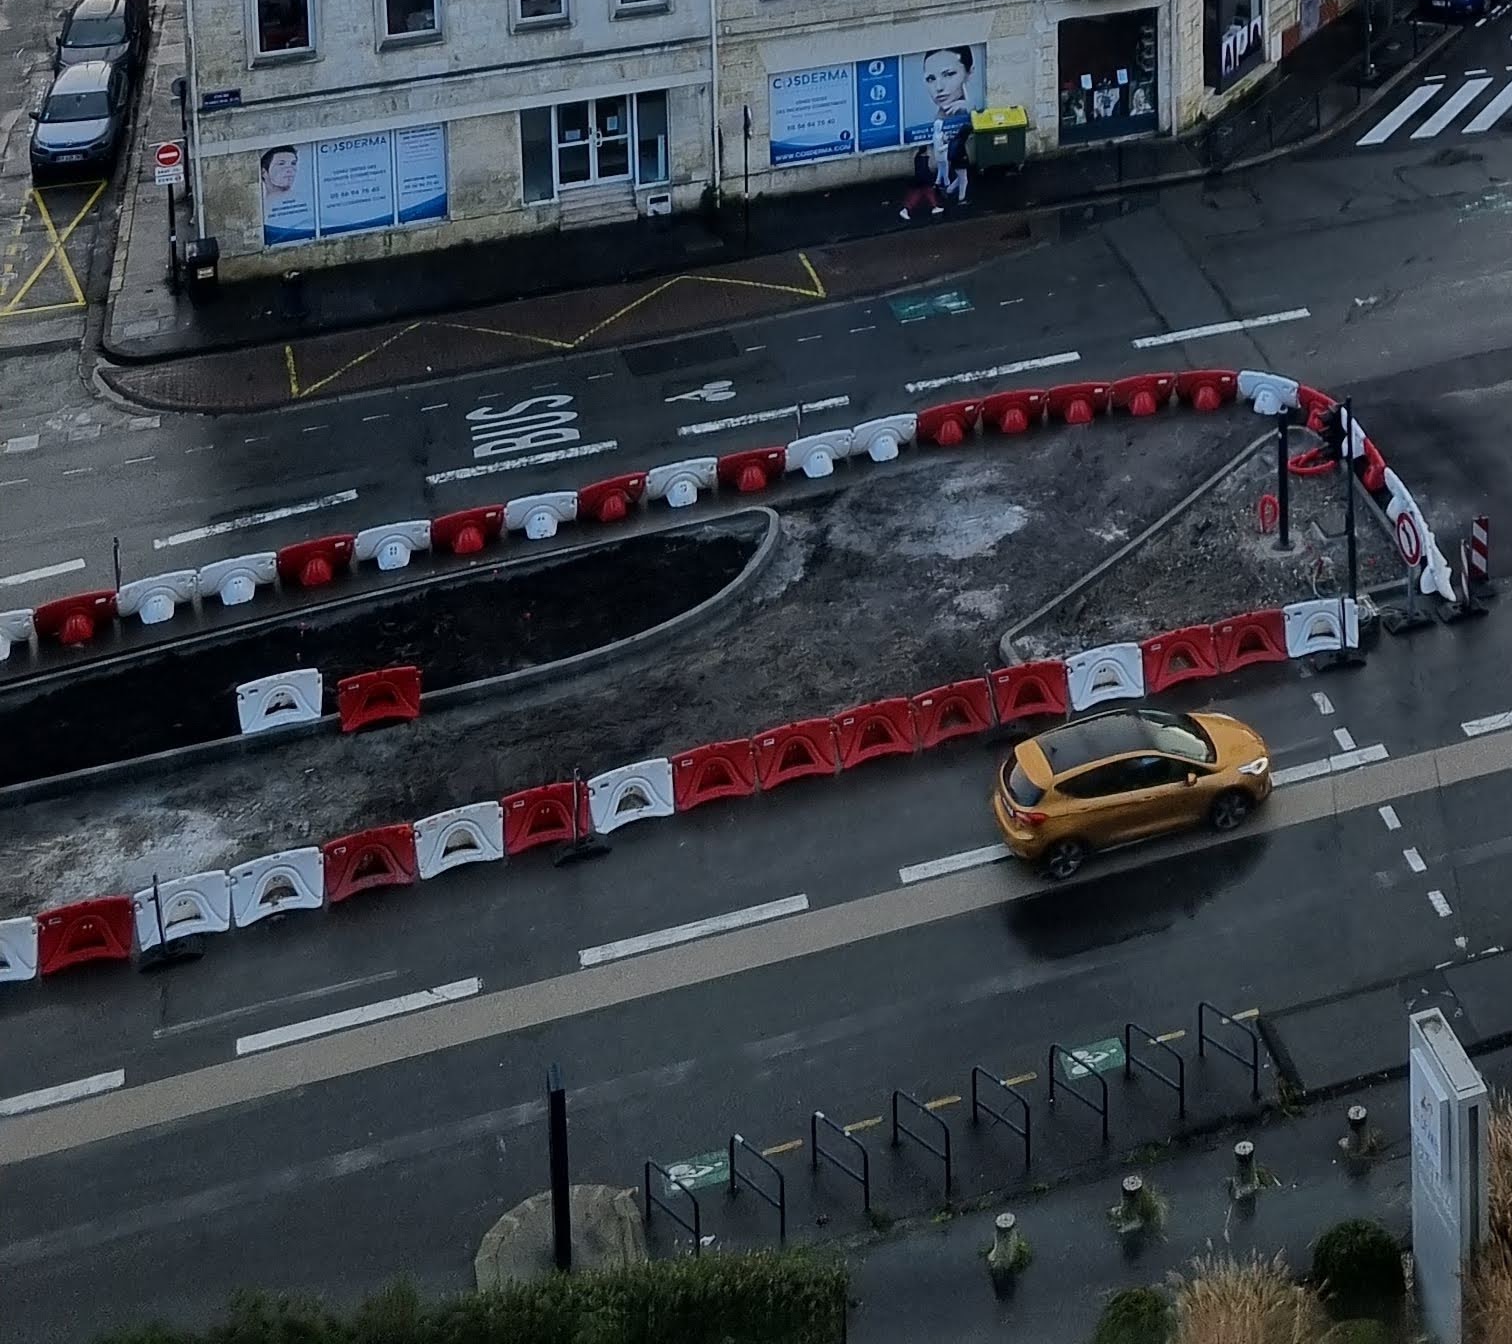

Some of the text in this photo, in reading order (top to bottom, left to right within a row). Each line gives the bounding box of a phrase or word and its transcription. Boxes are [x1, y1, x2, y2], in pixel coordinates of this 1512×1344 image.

[773, 69, 848, 89] COSDERMA
[320, 137, 387, 153] COSDERMA
[465, 393, 582, 459] BUS
